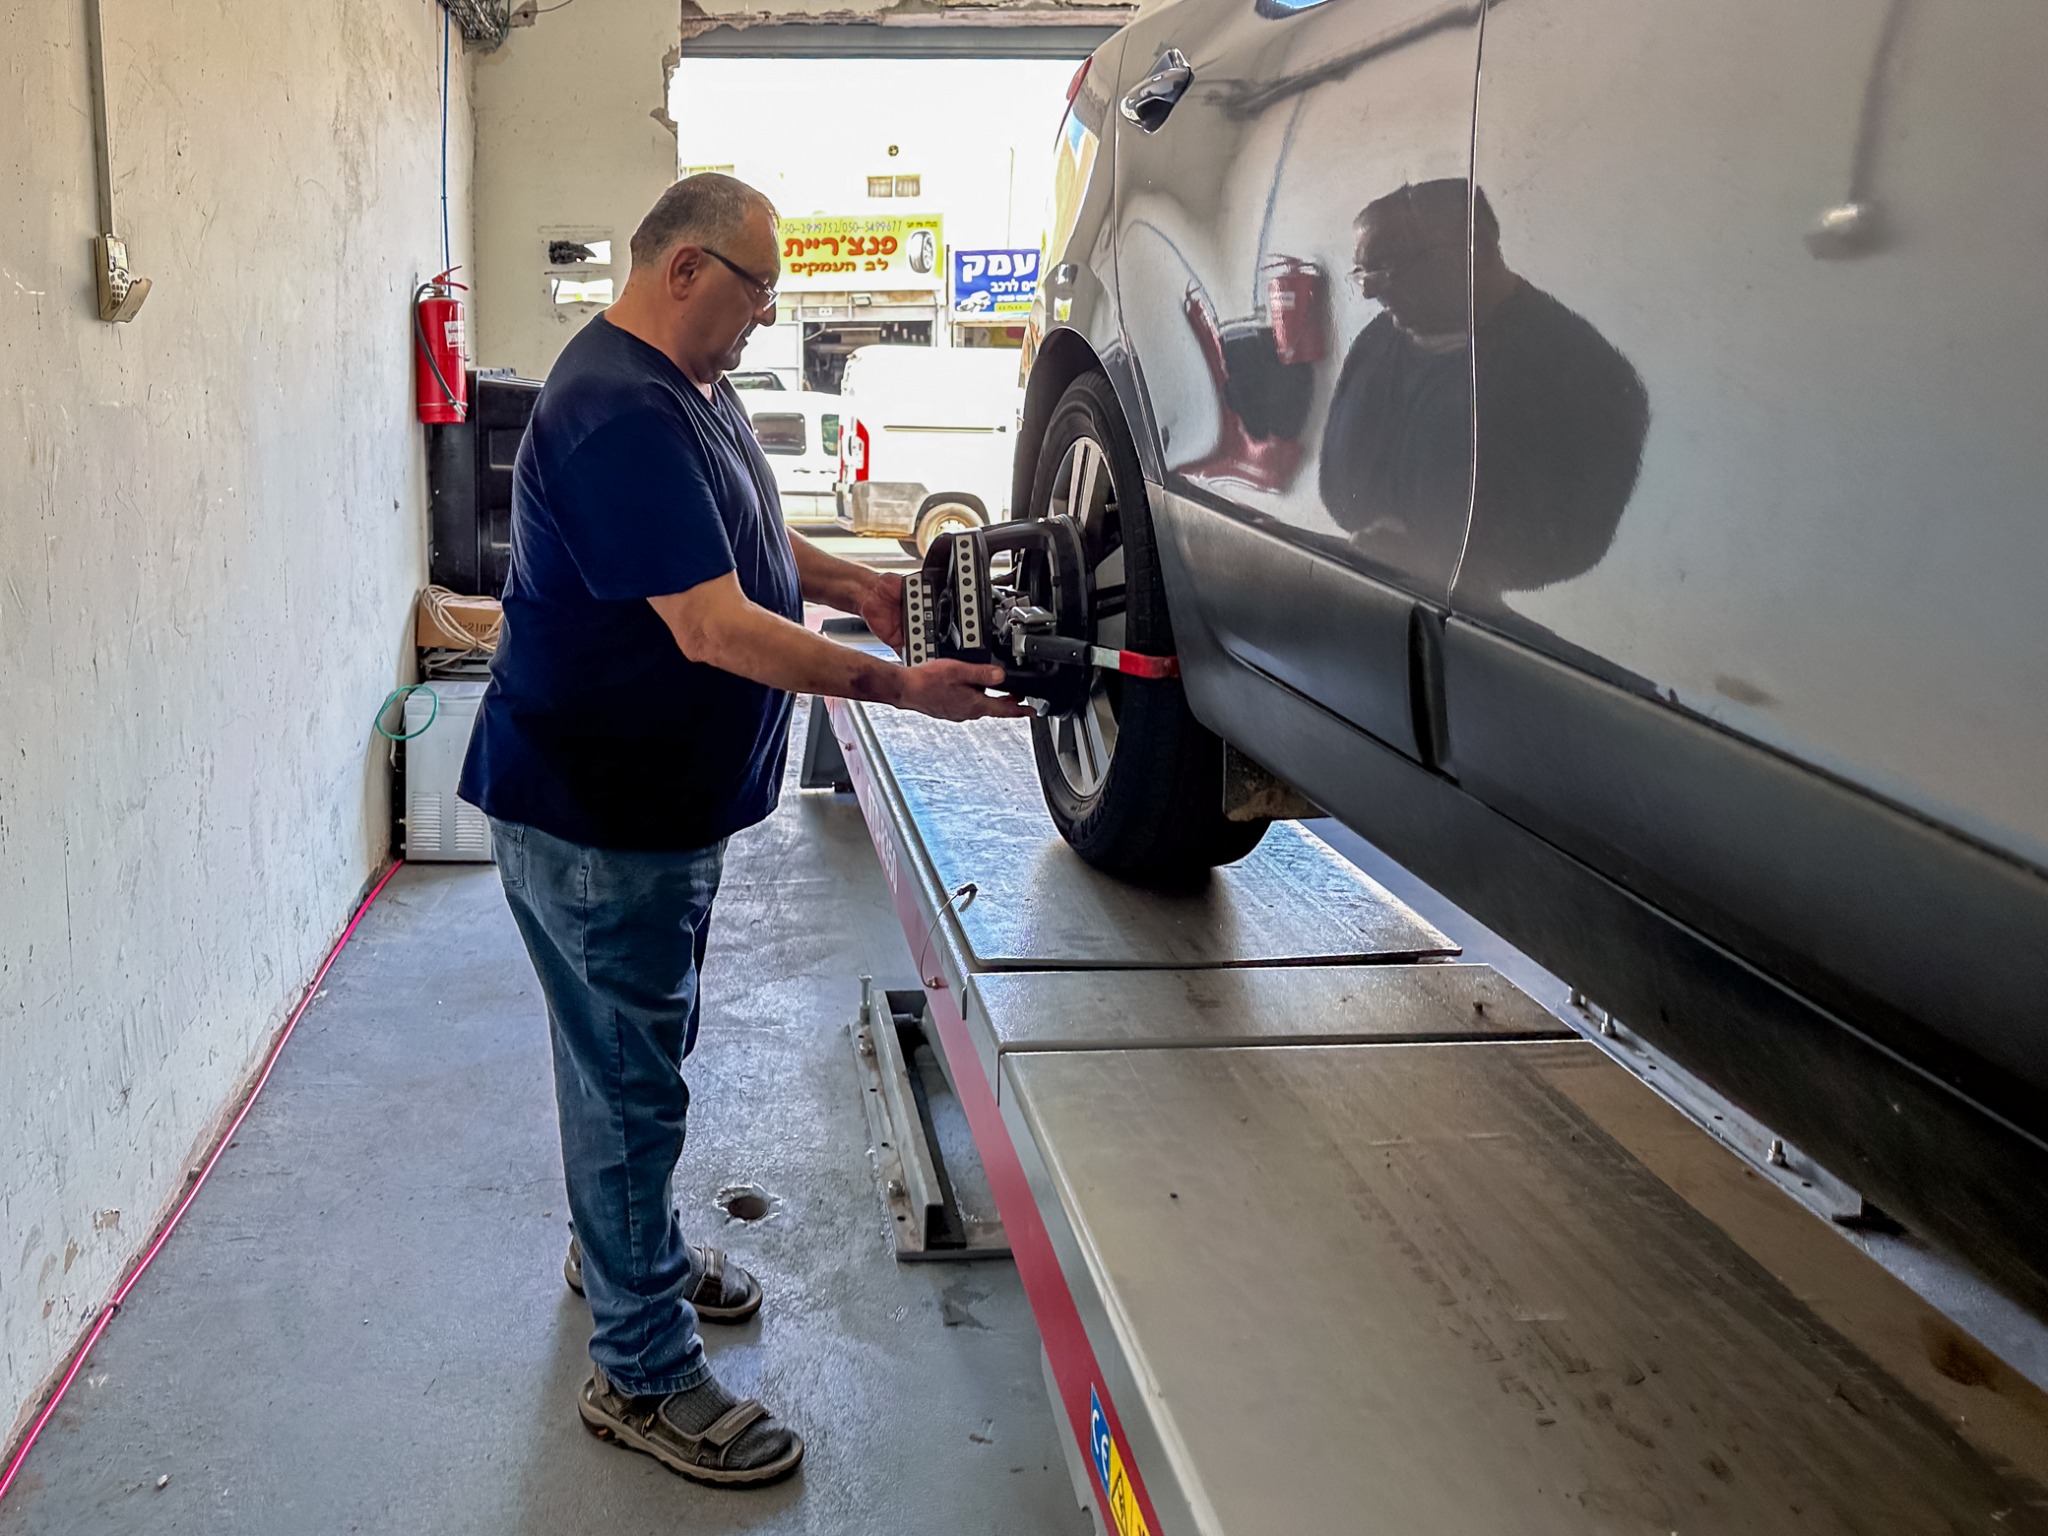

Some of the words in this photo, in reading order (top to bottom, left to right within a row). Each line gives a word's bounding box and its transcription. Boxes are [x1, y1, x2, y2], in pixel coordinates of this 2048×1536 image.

[791, 260, 856, 276] העמקים
[864, 258, 889, 272] לב
[962, 253, 1040, 283] עמק
[990, 278, 1019, 293] לרכב
